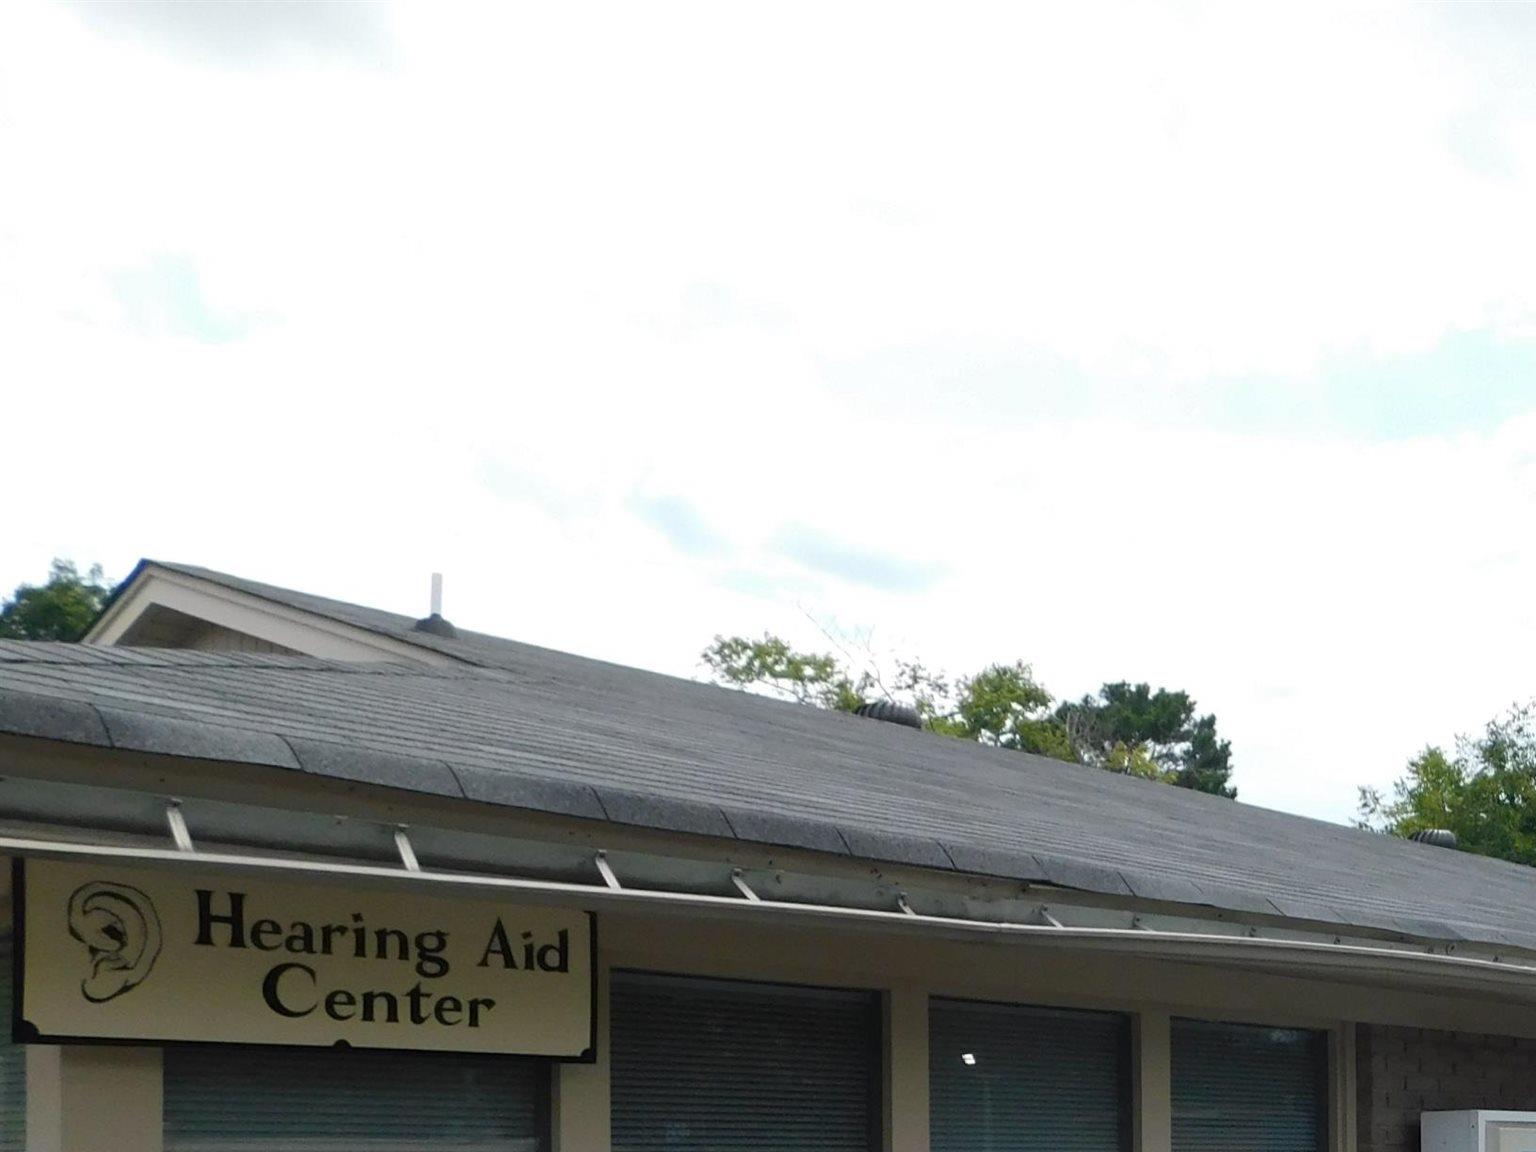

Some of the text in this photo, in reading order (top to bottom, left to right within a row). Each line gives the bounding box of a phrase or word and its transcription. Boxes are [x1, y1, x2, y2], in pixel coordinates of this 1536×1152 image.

[194, 888, 569, 979] Hearing Aid
[262, 962, 496, 1028] Center
